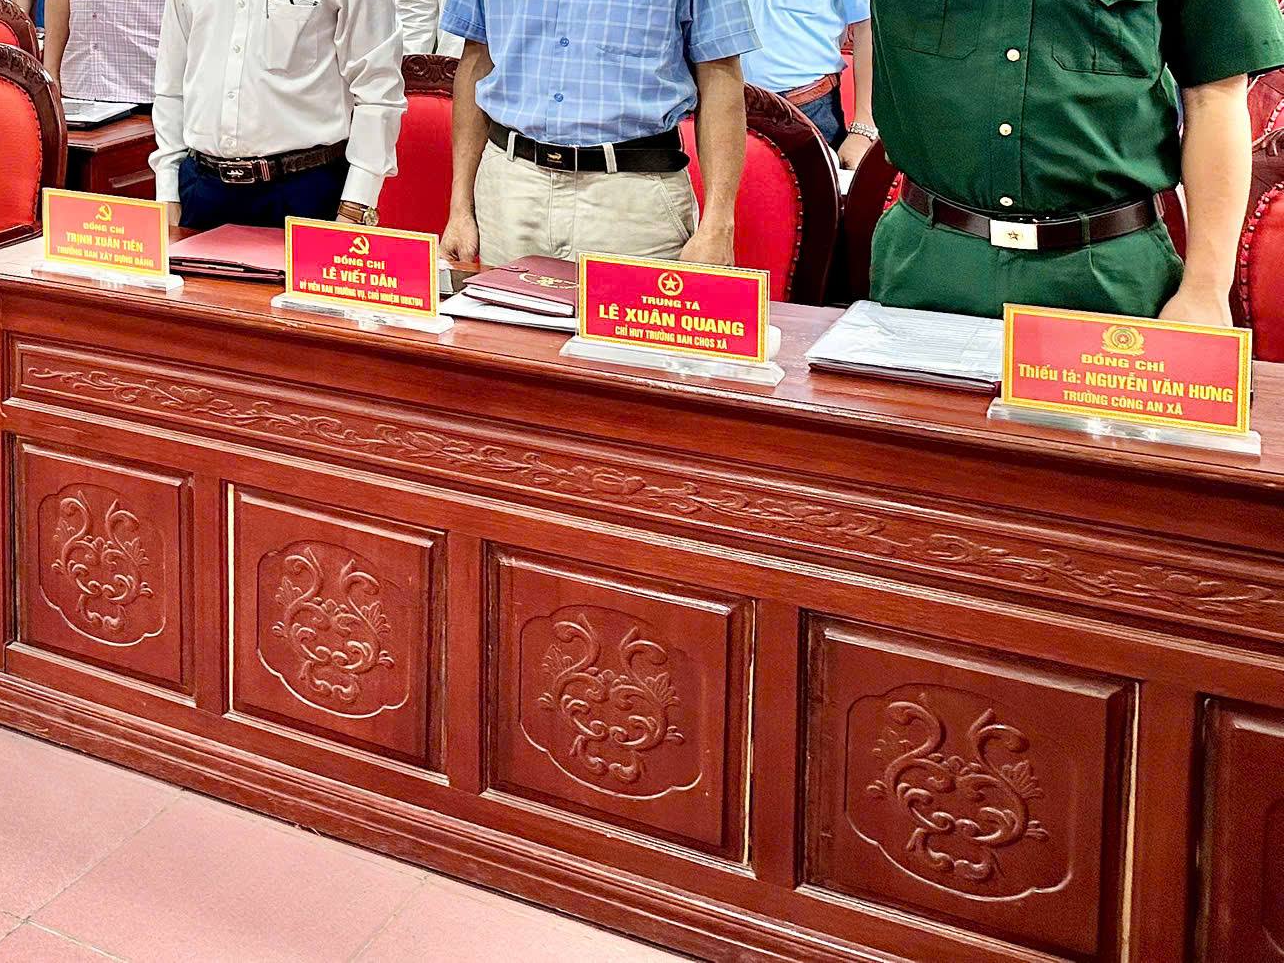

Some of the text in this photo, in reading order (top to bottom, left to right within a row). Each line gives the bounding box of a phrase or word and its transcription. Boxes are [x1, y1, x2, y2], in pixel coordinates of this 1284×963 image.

[99, 251, 113, 261] XÂY
[333, 255, 385, 270] ĐỒNG CHÍ
[322, 266, 337, 280] LÊ
[340, 268, 367, 284] VIẾT
[640, 295, 701, 311] TRUNG TÁ
[598, 303, 745, 336] LÊ XUÂN QUANG
[629, 328, 644, 338] HUY
[645, 329, 675, 343] TRƯỞNG
[676, 334, 692, 345] BAN
[716, 338, 728, 350] XÃ
[1080, 353, 1165, 373] ĐỒNG CHÍ
[1018, 363, 1234, 403] Thiếu tá: NGUYỄN VĂN HƯNG
[1063, 390, 1183, 416] TRƯỞNG CÔNG AN XÃ
